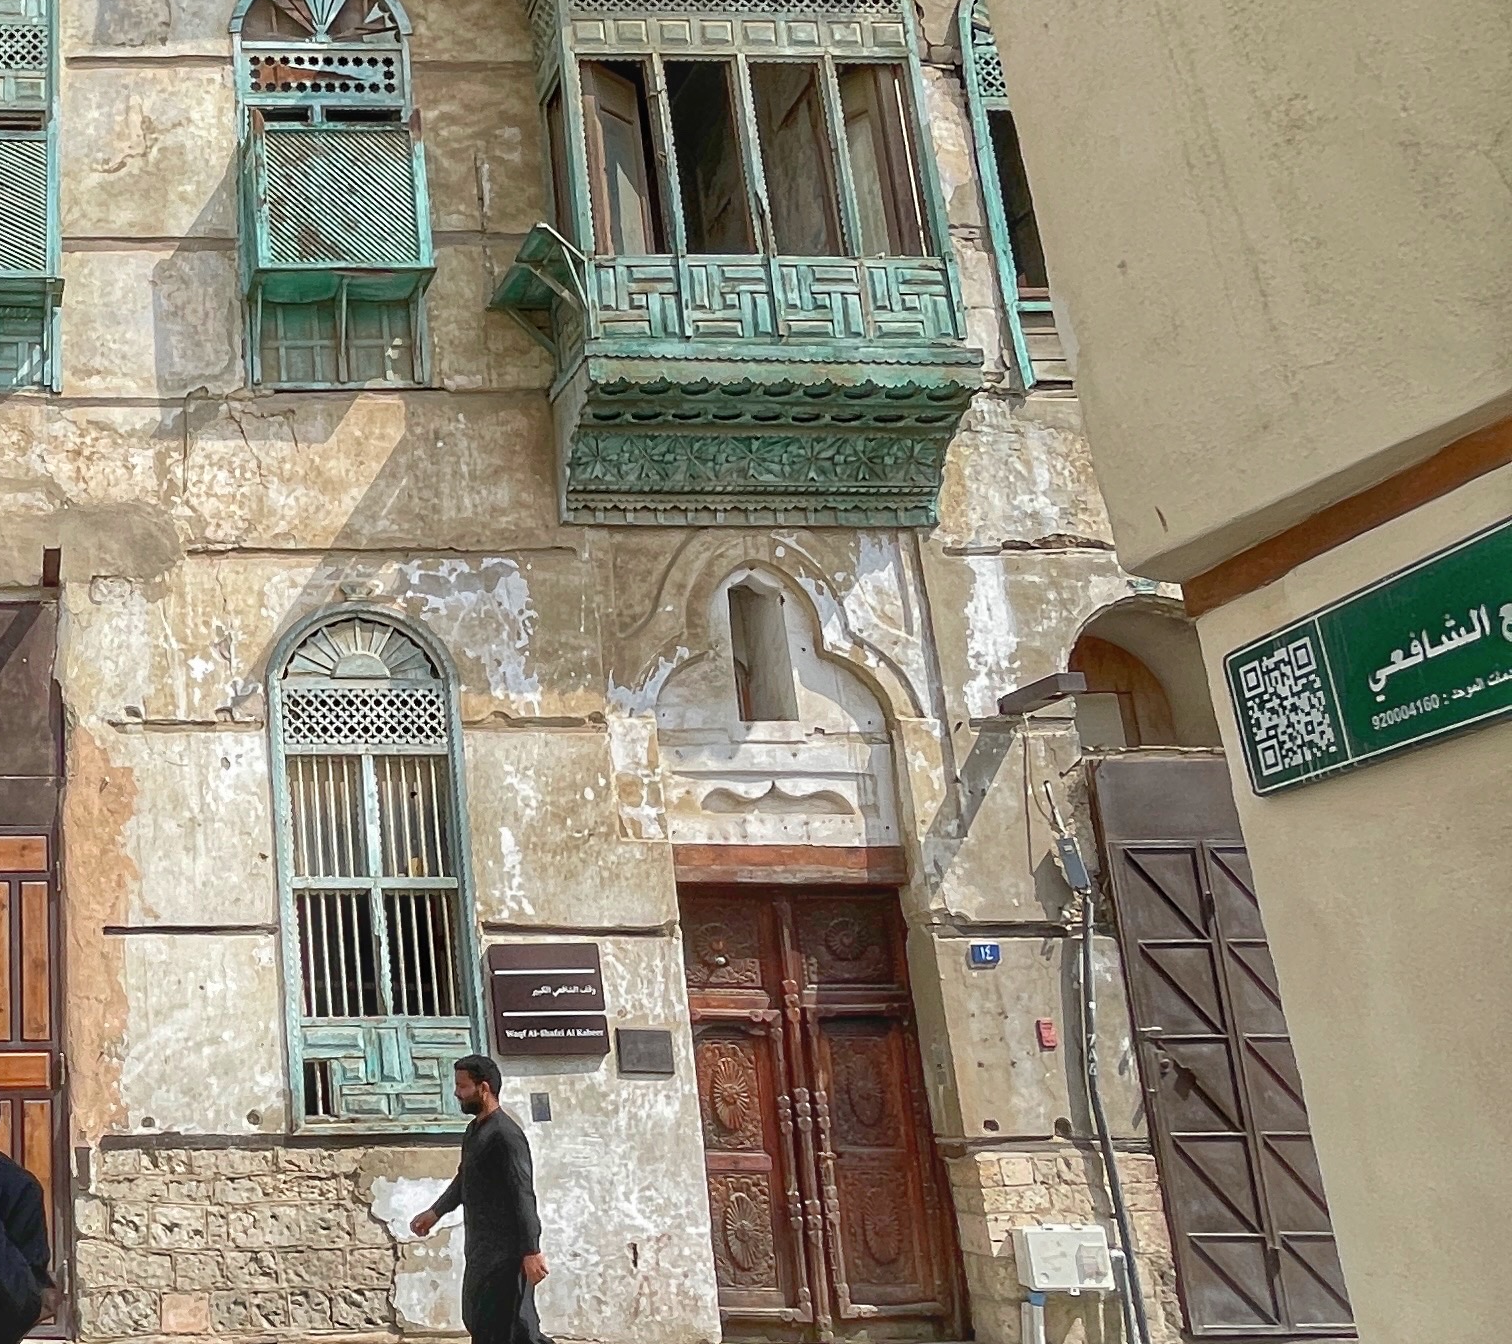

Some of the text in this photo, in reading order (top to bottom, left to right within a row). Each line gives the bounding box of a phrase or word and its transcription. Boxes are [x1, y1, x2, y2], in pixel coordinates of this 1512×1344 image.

[1368, 604, 1491, 703] الشافعي
[1371, 693, 1440, 731] 920004160
[980, 945, 994, 960] ١٤
[505, 1029, 528, 1040] Waqf
